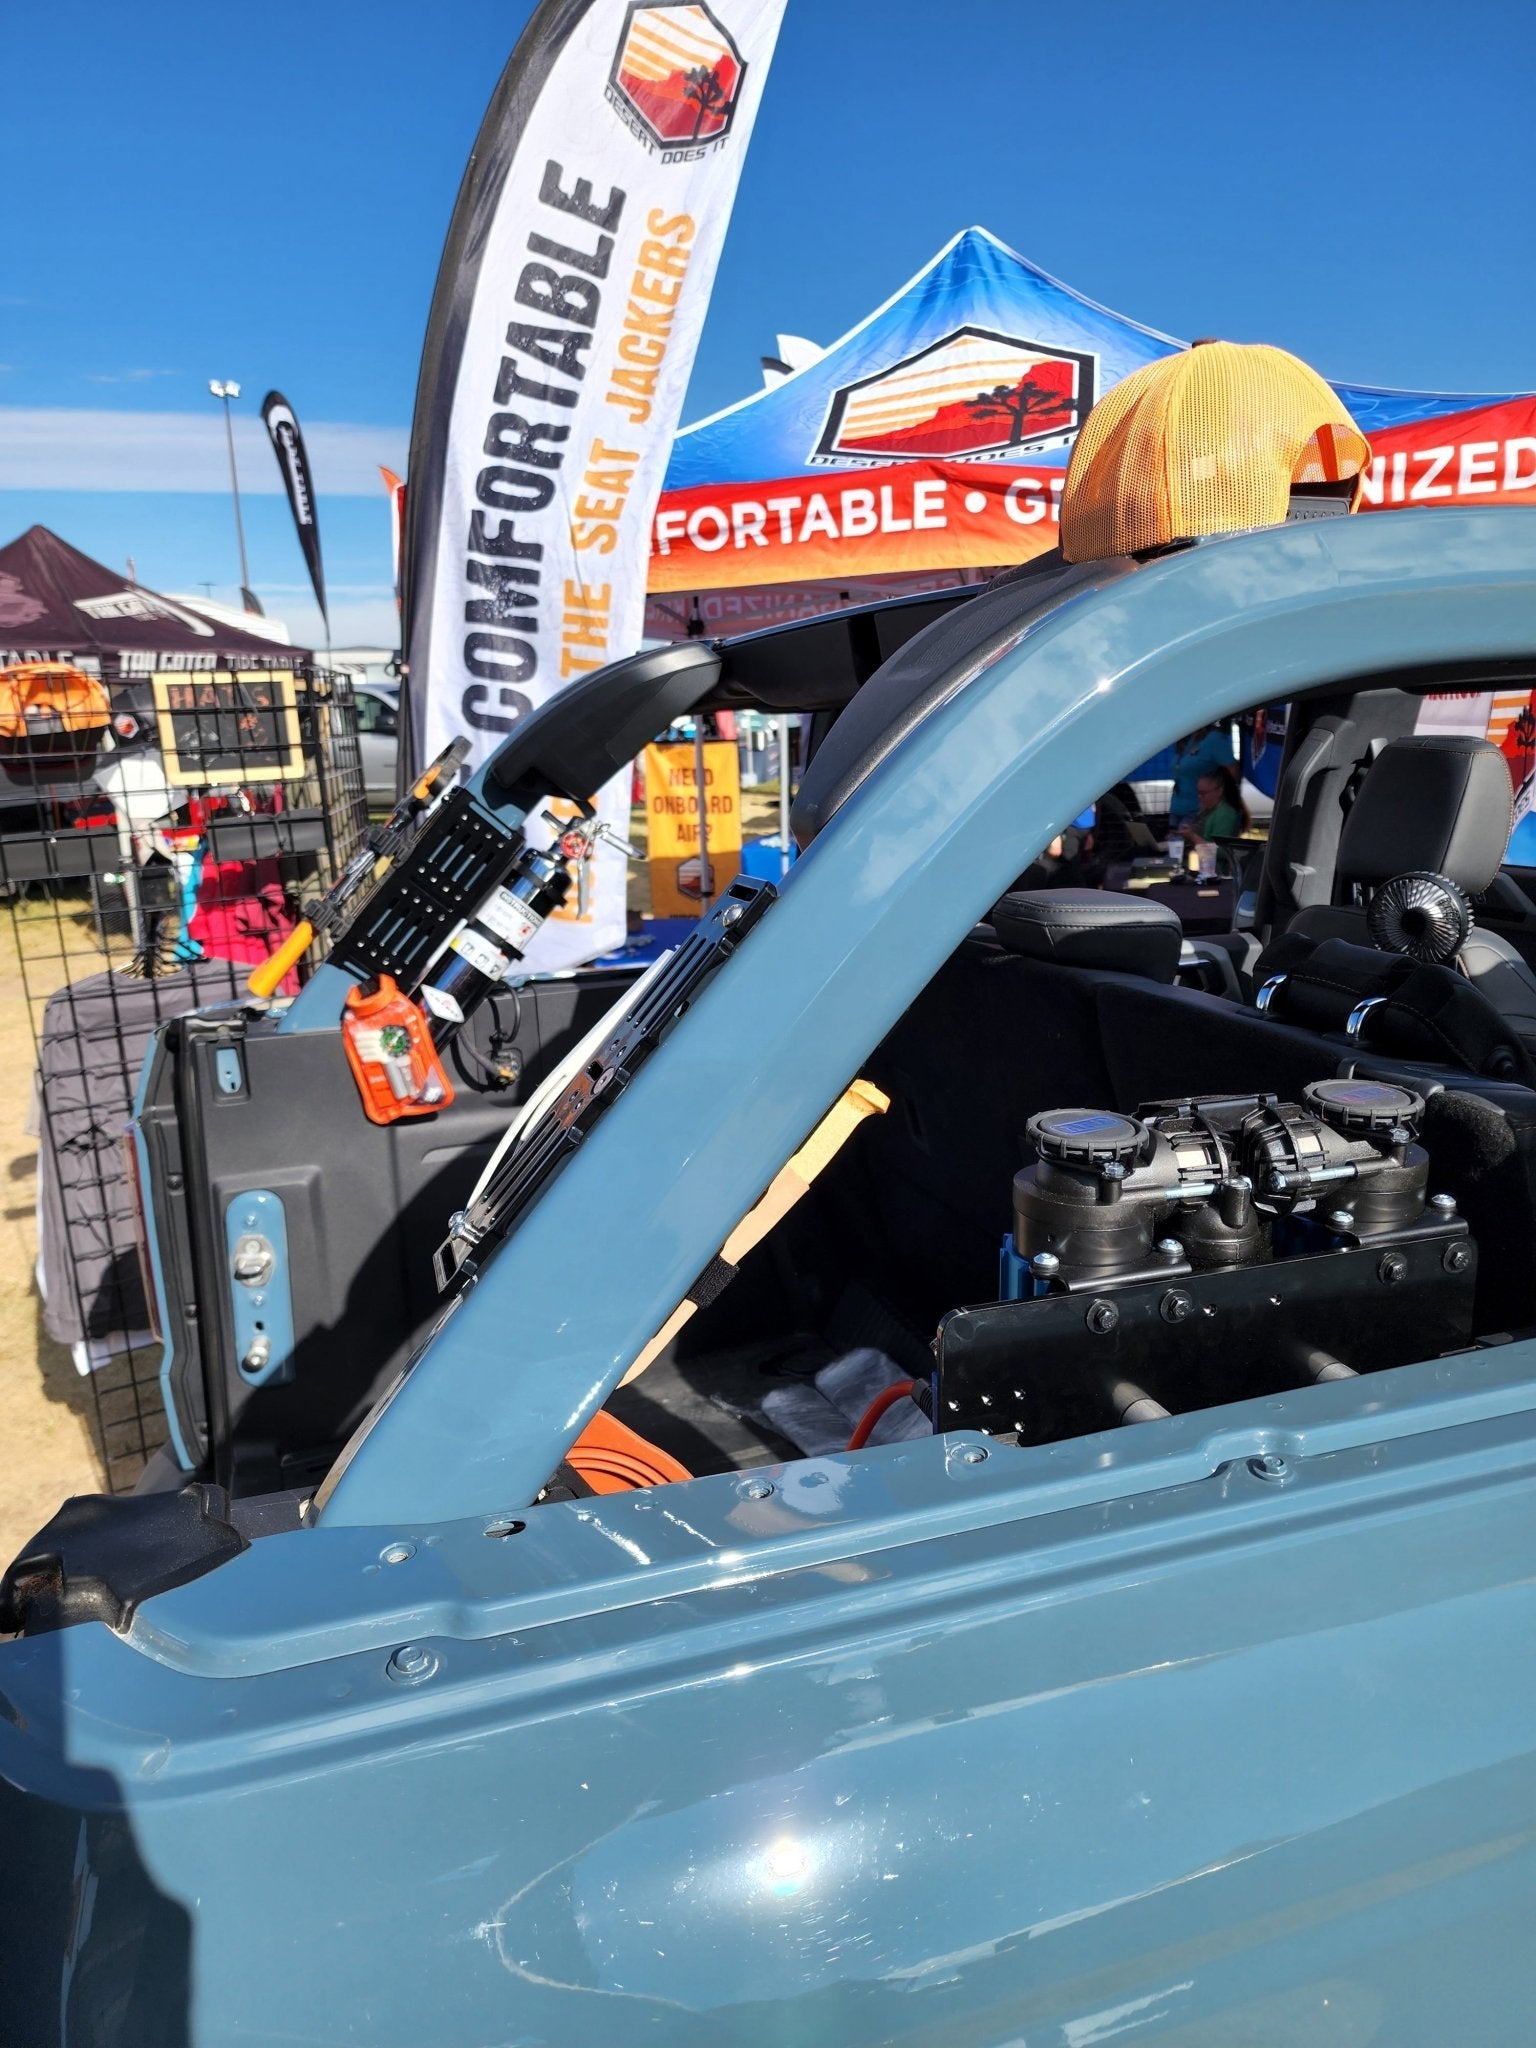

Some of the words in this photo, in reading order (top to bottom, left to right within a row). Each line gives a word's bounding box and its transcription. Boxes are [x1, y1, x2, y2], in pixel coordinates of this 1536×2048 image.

[661, 147, 707, 165] DOES
[713, 137, 730, 153] IT
[606, 208, 697, 424] JACKERS
[461, 159, 627, 733] COMFORTABLE
[571, 438, 640, 555] SEAT
[650, 479, 948, 558] FORTABLE
[560, 578, 612, 679] THE
[653, 795, 732, 815] ONBORD
